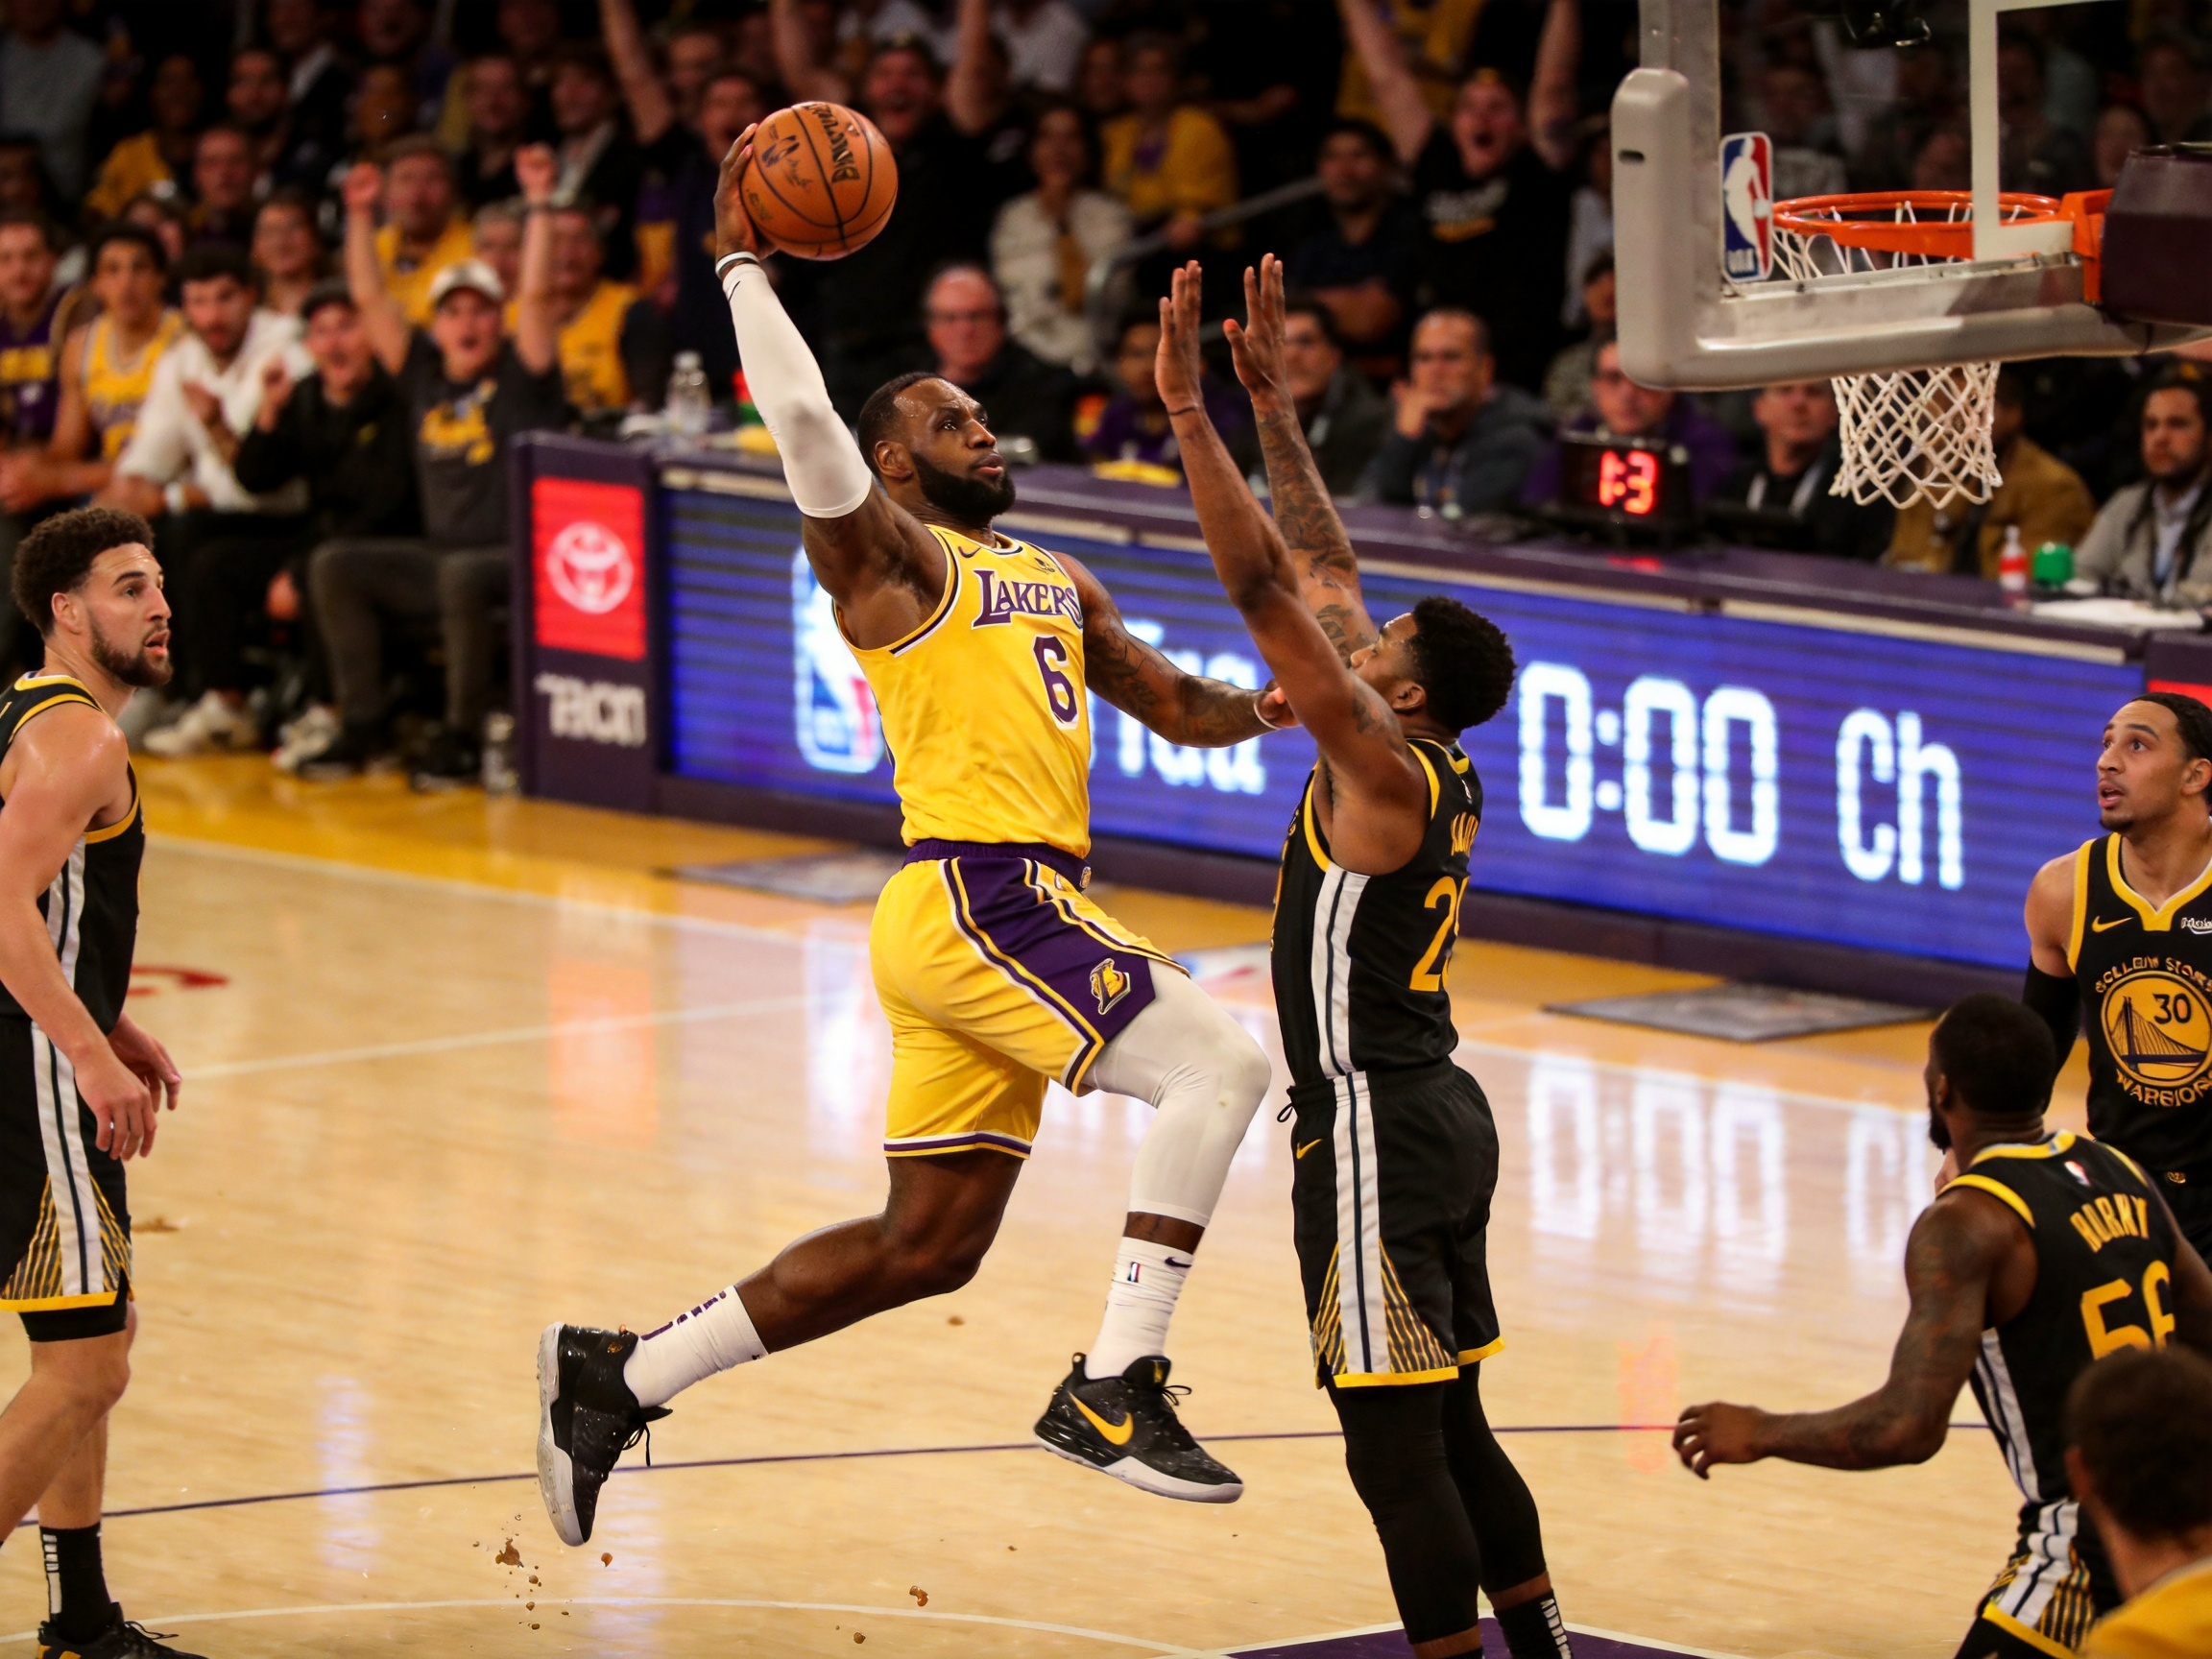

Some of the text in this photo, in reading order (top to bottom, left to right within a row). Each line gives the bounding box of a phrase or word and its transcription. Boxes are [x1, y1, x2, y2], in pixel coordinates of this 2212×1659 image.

[972, 568, 1083, 631] LAKERS
[1032, 634, 1079, 730] 6
[1518, 660, 1779, 866] 0:00
[1836, 708, 1964, 891] Ch
[1409, 876, 1470, 993] 2
[2152, 993, 2192, 1024] 30
